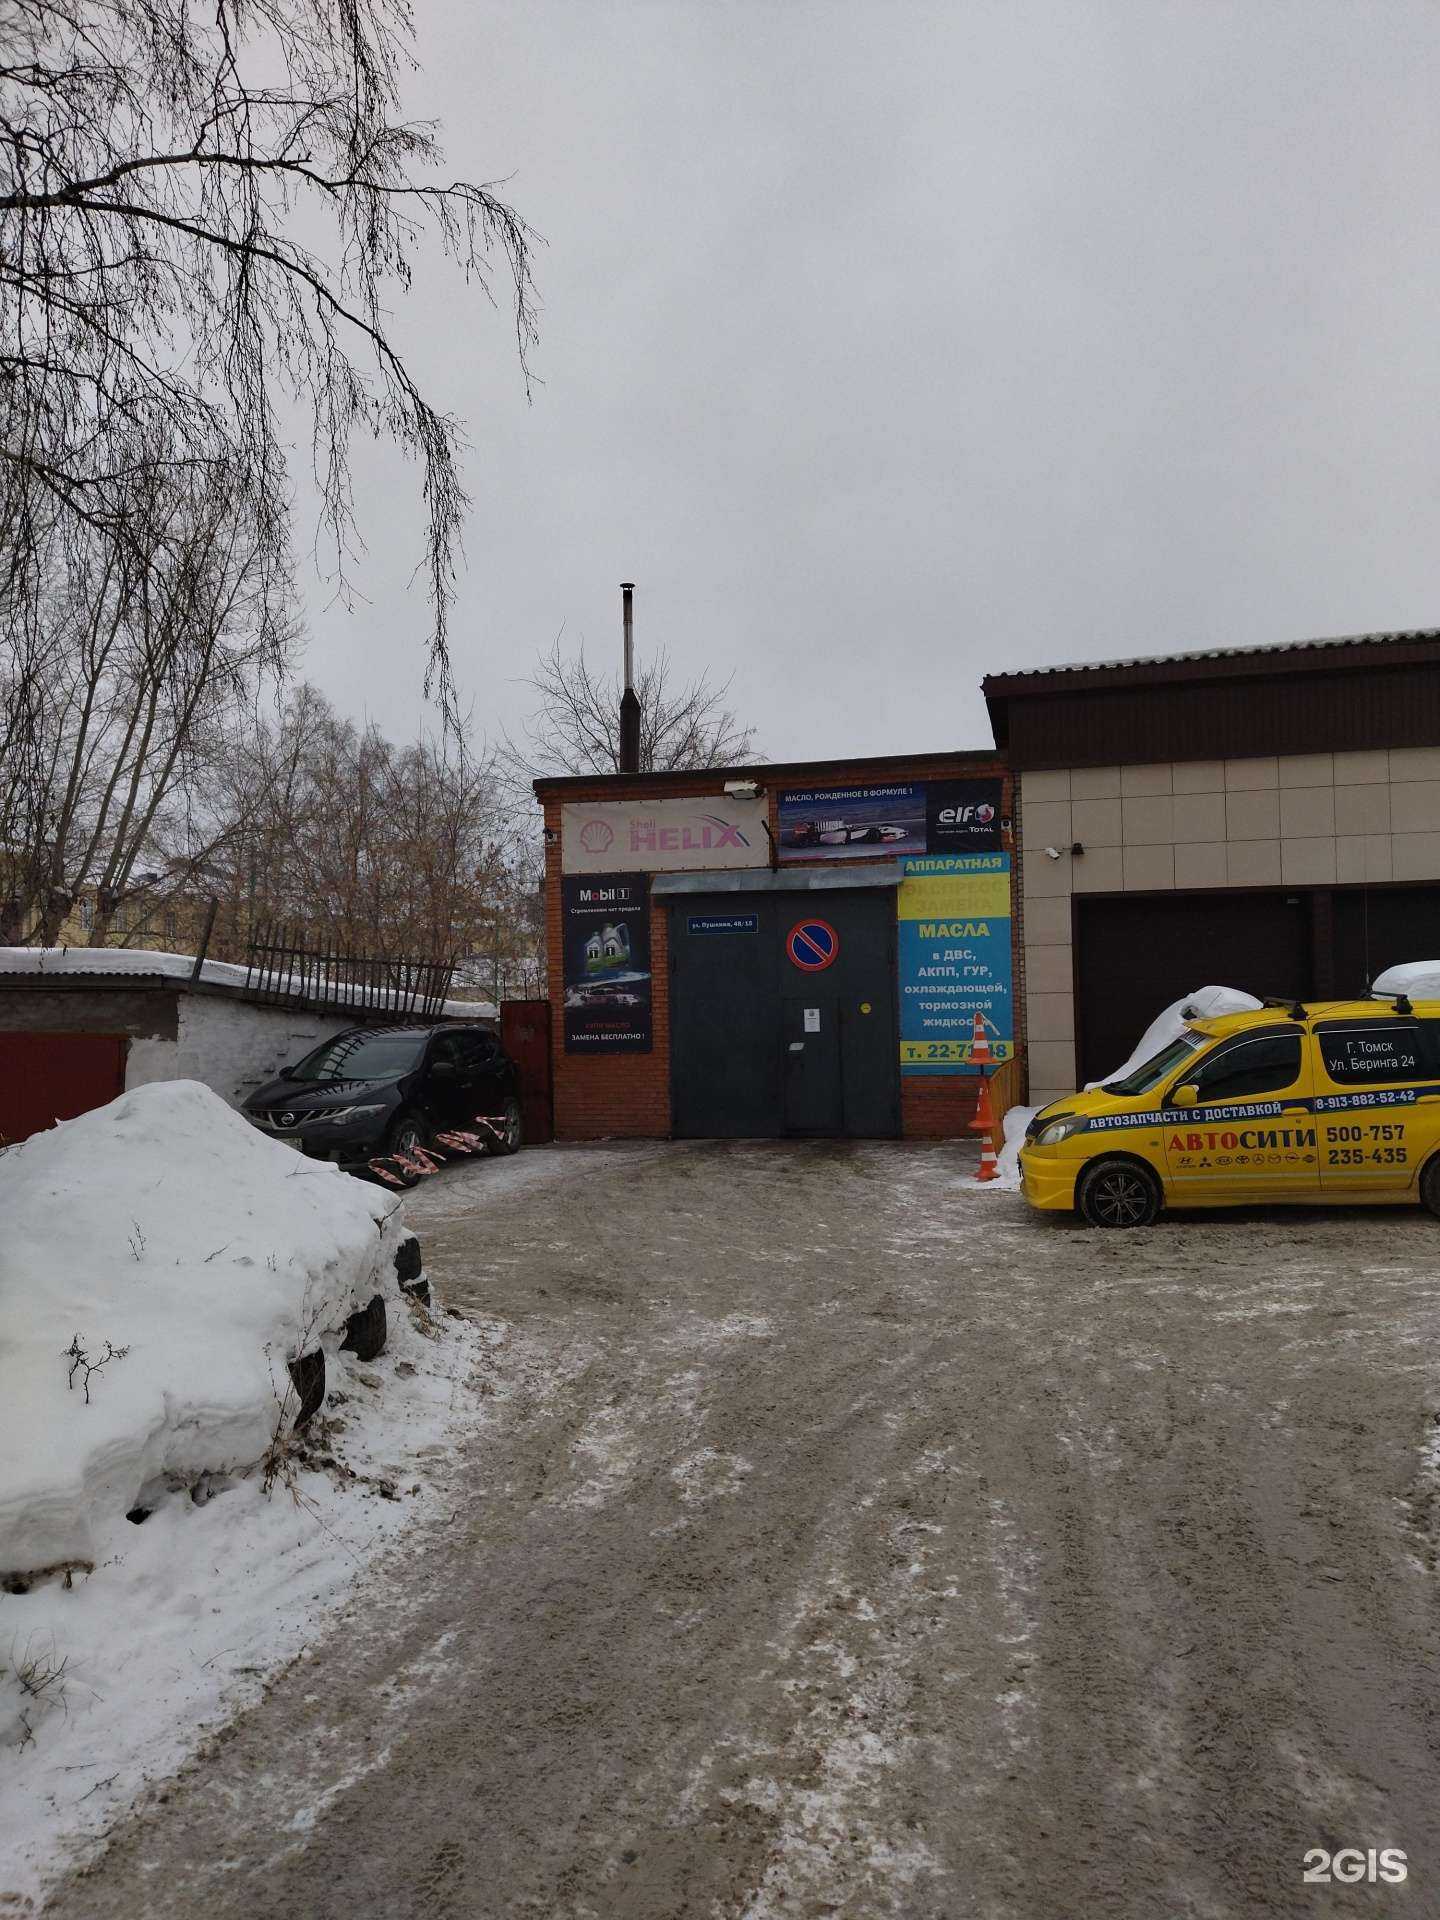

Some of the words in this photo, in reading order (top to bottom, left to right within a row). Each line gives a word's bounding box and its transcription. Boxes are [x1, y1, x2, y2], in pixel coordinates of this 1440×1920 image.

[785, 794, 814, 802] МАСЛО,
[815, 790, 862, 801] РОЖДЕННОЕ
[869, 788, 907, 797] ФОРМУЛЕ
[938, 806, 975, 823] elf
[629, 822, 744, 852] HELIX
[905, 857, 1002, 872] АППАРАТНАЯ
[580, 888, 615, 901] Mobil
[919, 922, 991, 938] МАСЛА
[943, 949, 977, 962] ДВС,
[918, 966, 960, 979] АКПП,
[963, 965, 993, 978] ГУР,
[904, 982, 1008, 994] охлаждающей,
[919, 1000, 992, 1012] тормозной
[1346, 1042, 1356, 1054] Г.
[1358, 1041, 1395, 1053] Томск
[1330, 1059, 1348, 1071] Ул.
[1350, 1057, 1398, 1072] Беринга
[1400, 1055, 1416, 1067] 24
[1316, 1090, 1416, 1110] 8-913-882-52-42
[1090, 1109, 1189, 1129] АВТОЗАПЧАСТИ
[1193, 1109, 1201, 1120] С
[1205, 1101, 1283, 1122] ДОСТАВКОЙ
[1168, 1128, 1317, 1153] АВТОСИТИ
[1326, 1124, 1406, 1143] 500-757
[1328, 1147, 1408, 1165] 235-435
